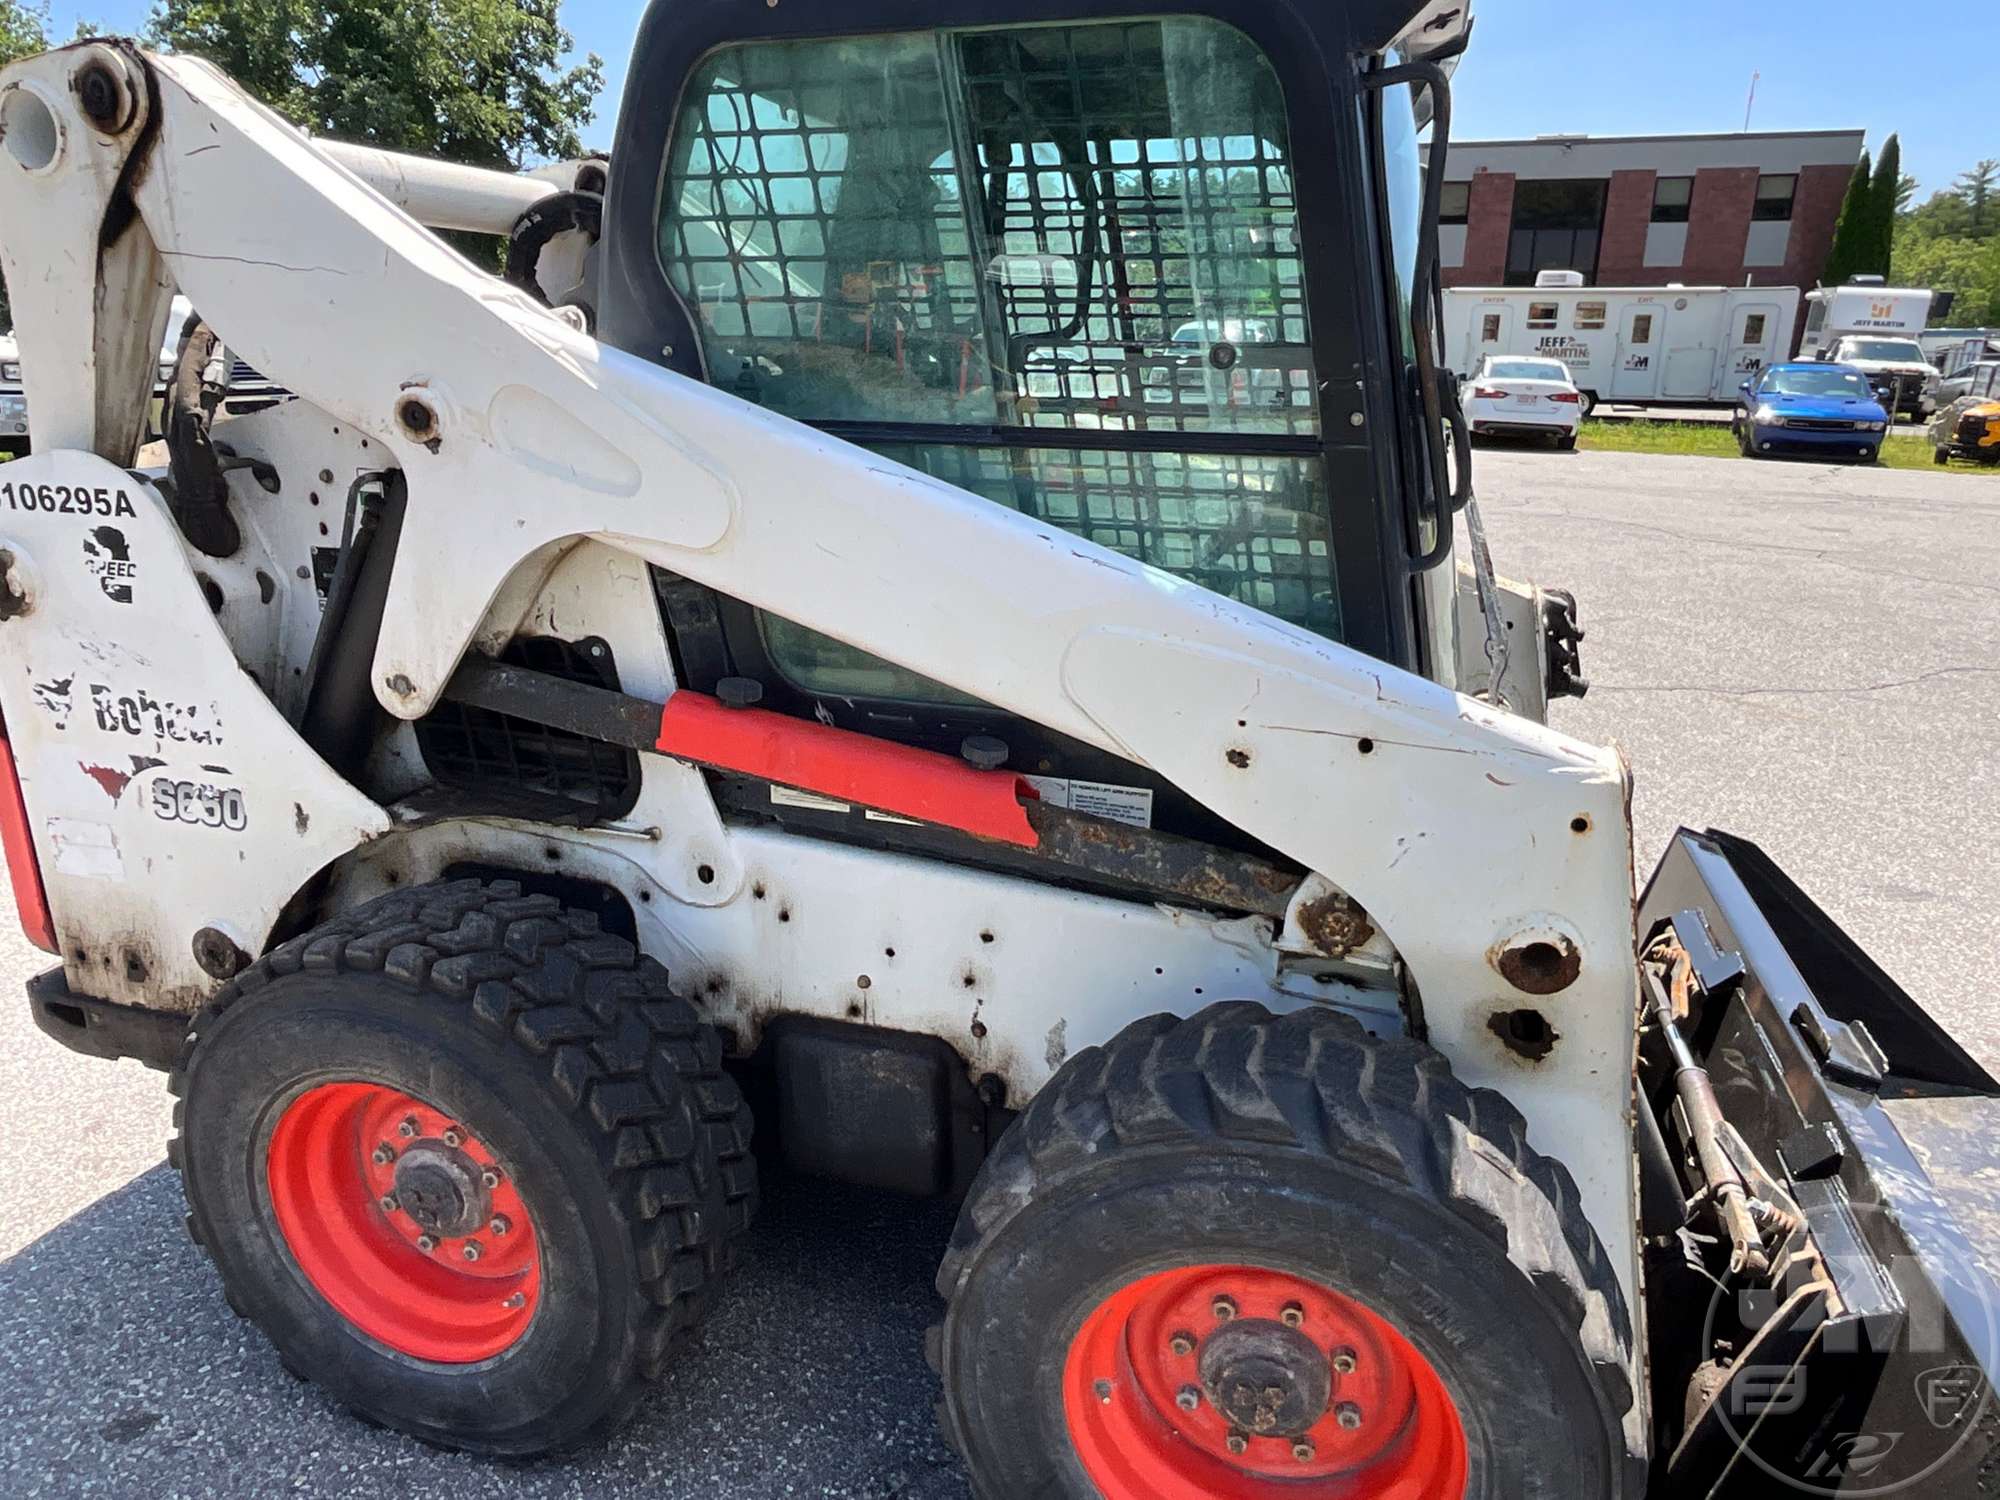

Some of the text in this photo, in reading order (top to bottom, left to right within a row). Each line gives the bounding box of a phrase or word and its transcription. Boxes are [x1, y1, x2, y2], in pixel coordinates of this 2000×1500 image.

[1873, 320, 1905, 328] MARTIN
[1535, 337, 1567, 351] JEFF
[1541, 348, 1586, 358] MARTIN
[0, 482, 137, 518] 106295A
